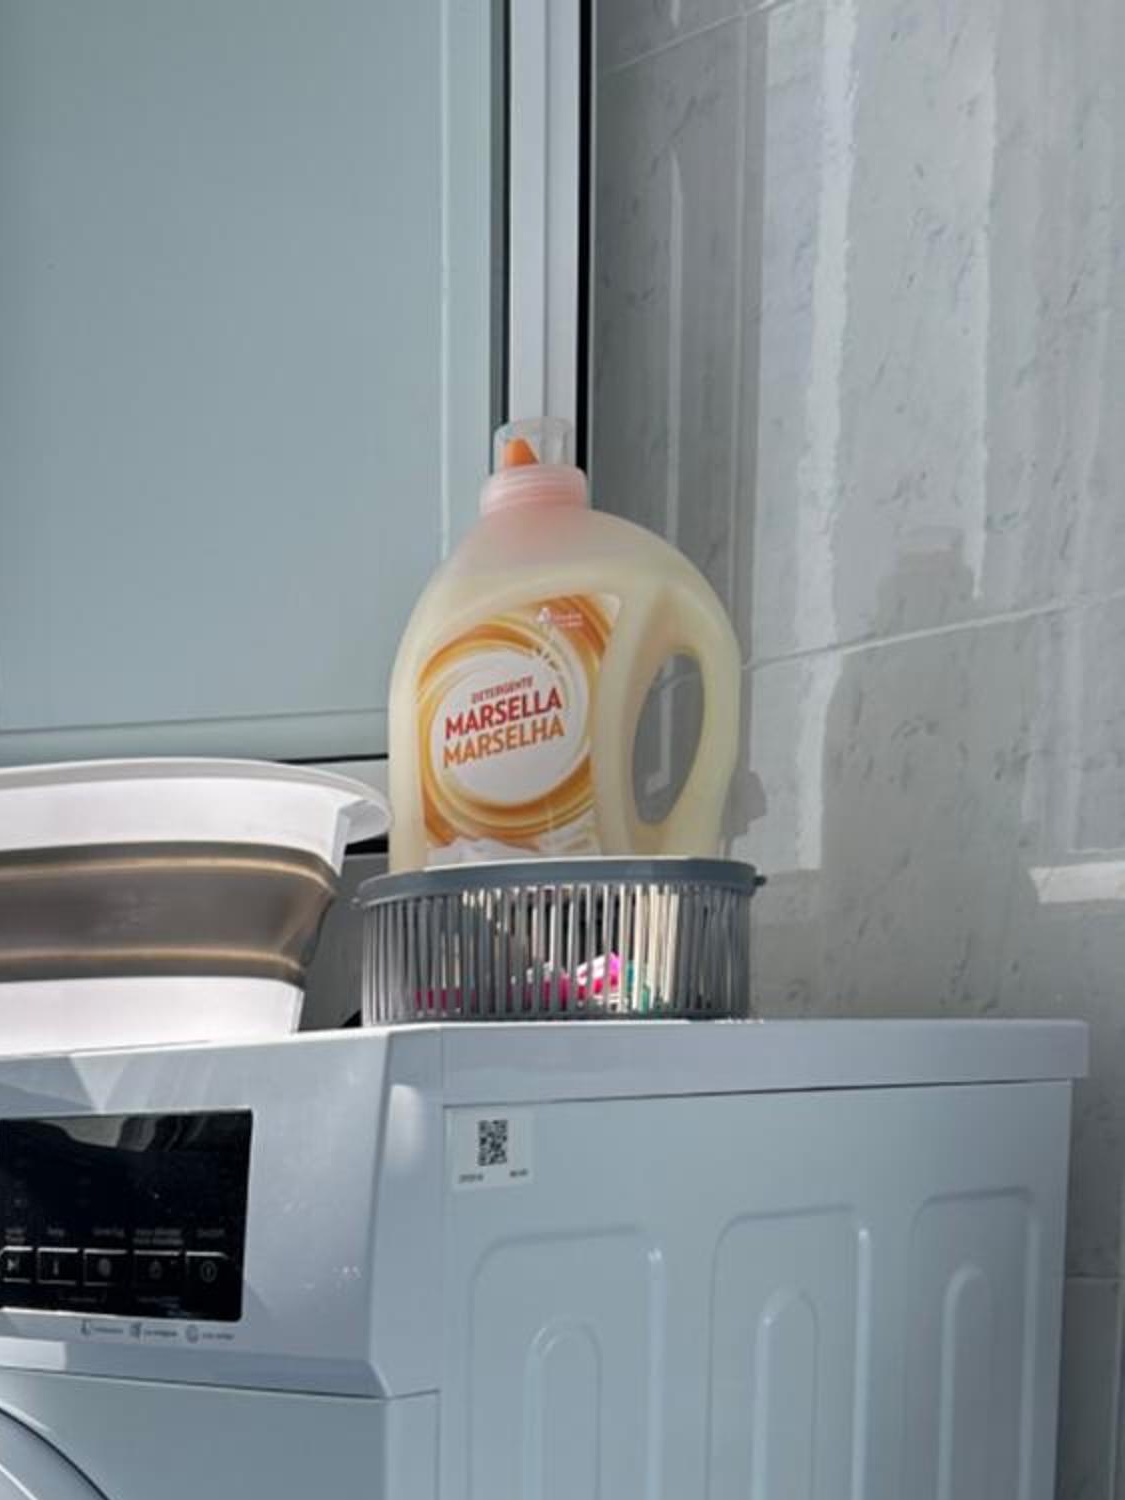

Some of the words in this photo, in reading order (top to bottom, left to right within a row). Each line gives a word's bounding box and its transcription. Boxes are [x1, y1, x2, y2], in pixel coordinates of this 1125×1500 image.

[445, 687, 562, 739] MARSELLA
[472, 676, 533, 704] DETERGENTE
[443, 714, 565, 768] MARSELHA
